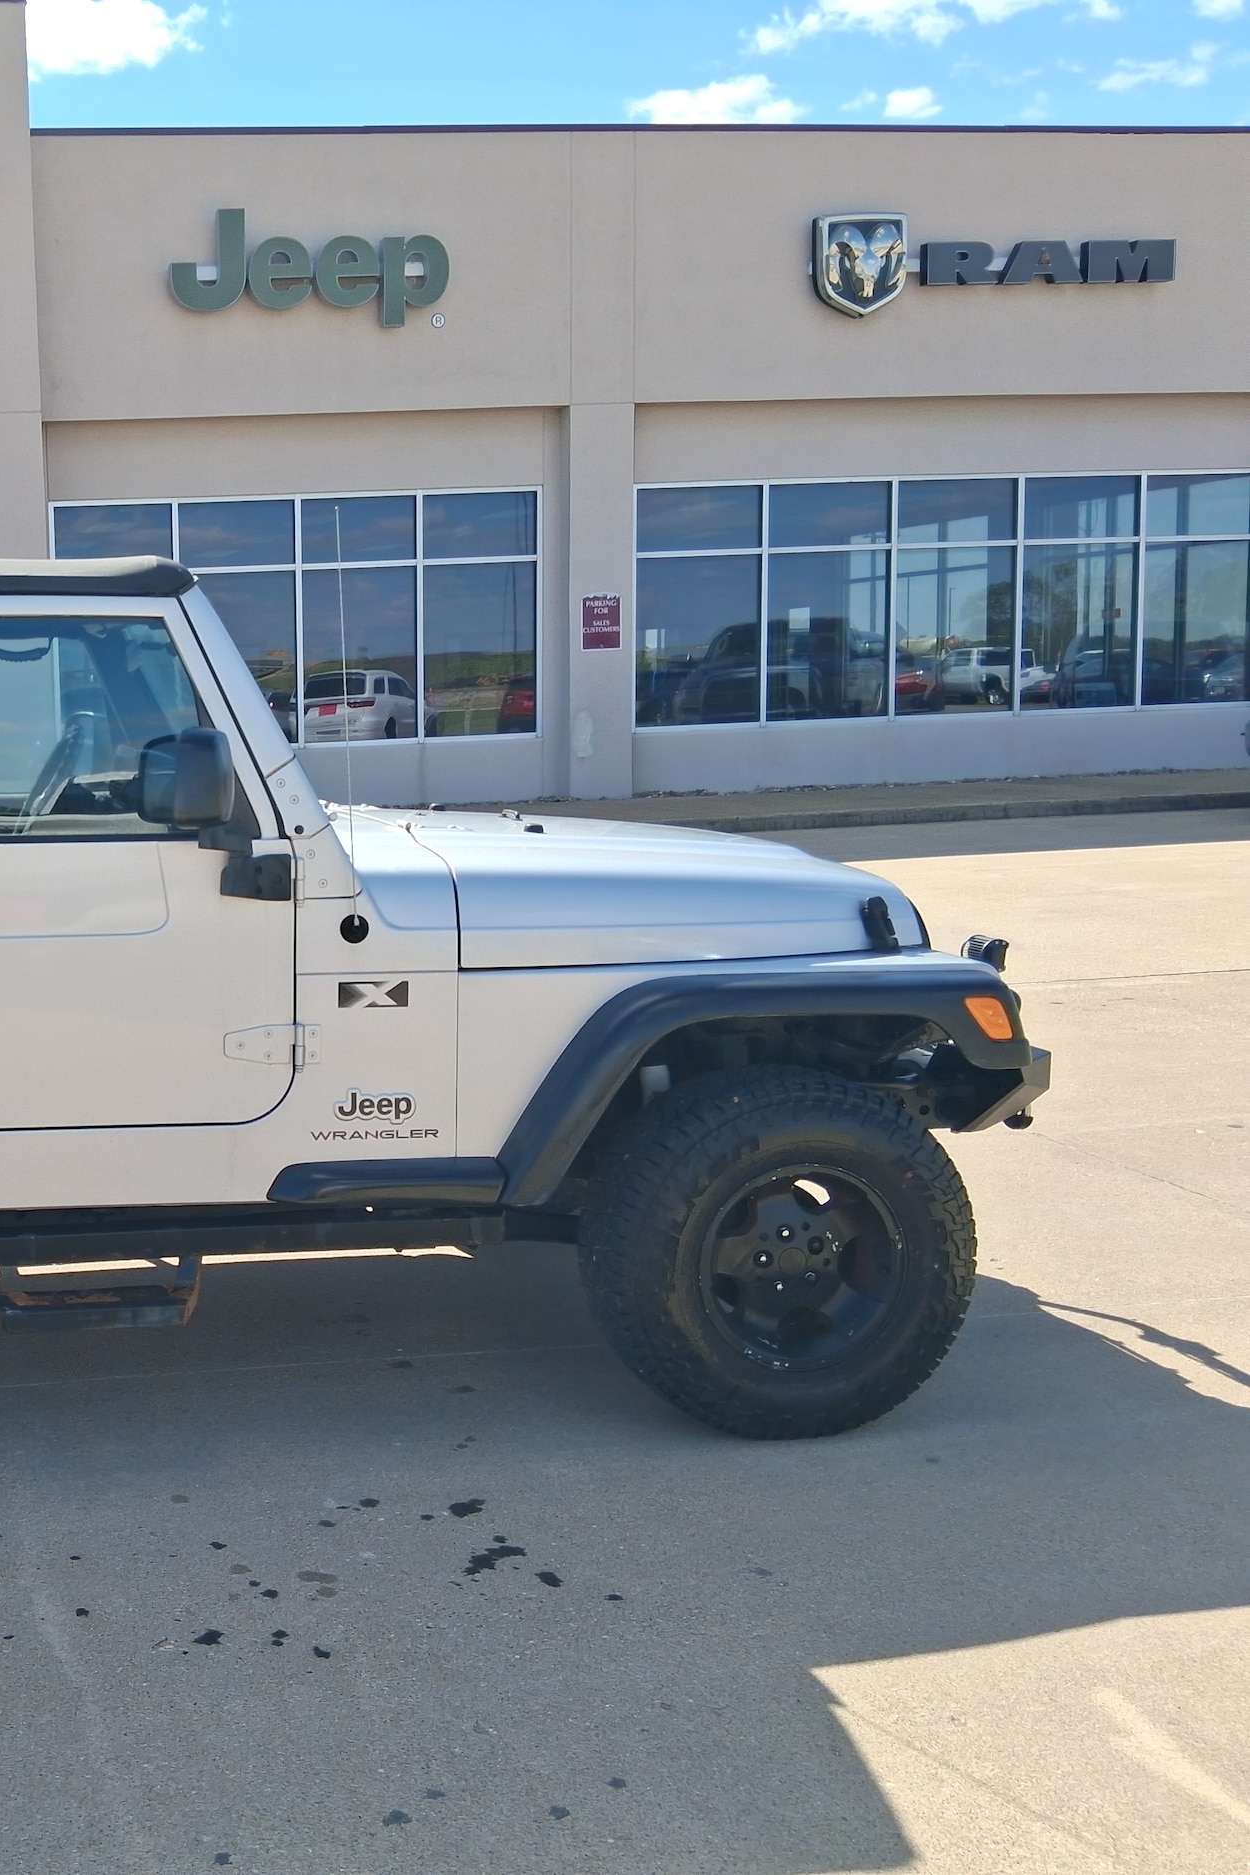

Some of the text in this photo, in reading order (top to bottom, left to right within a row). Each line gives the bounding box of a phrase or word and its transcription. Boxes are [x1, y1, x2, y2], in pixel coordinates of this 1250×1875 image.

[168, 207, 450, 327] Jeep
[920, 238, 1177, 286] RAM
[338, 1092, 412, 1120] Jeep
[310, 1129, 439, 1141] WRANGLER
